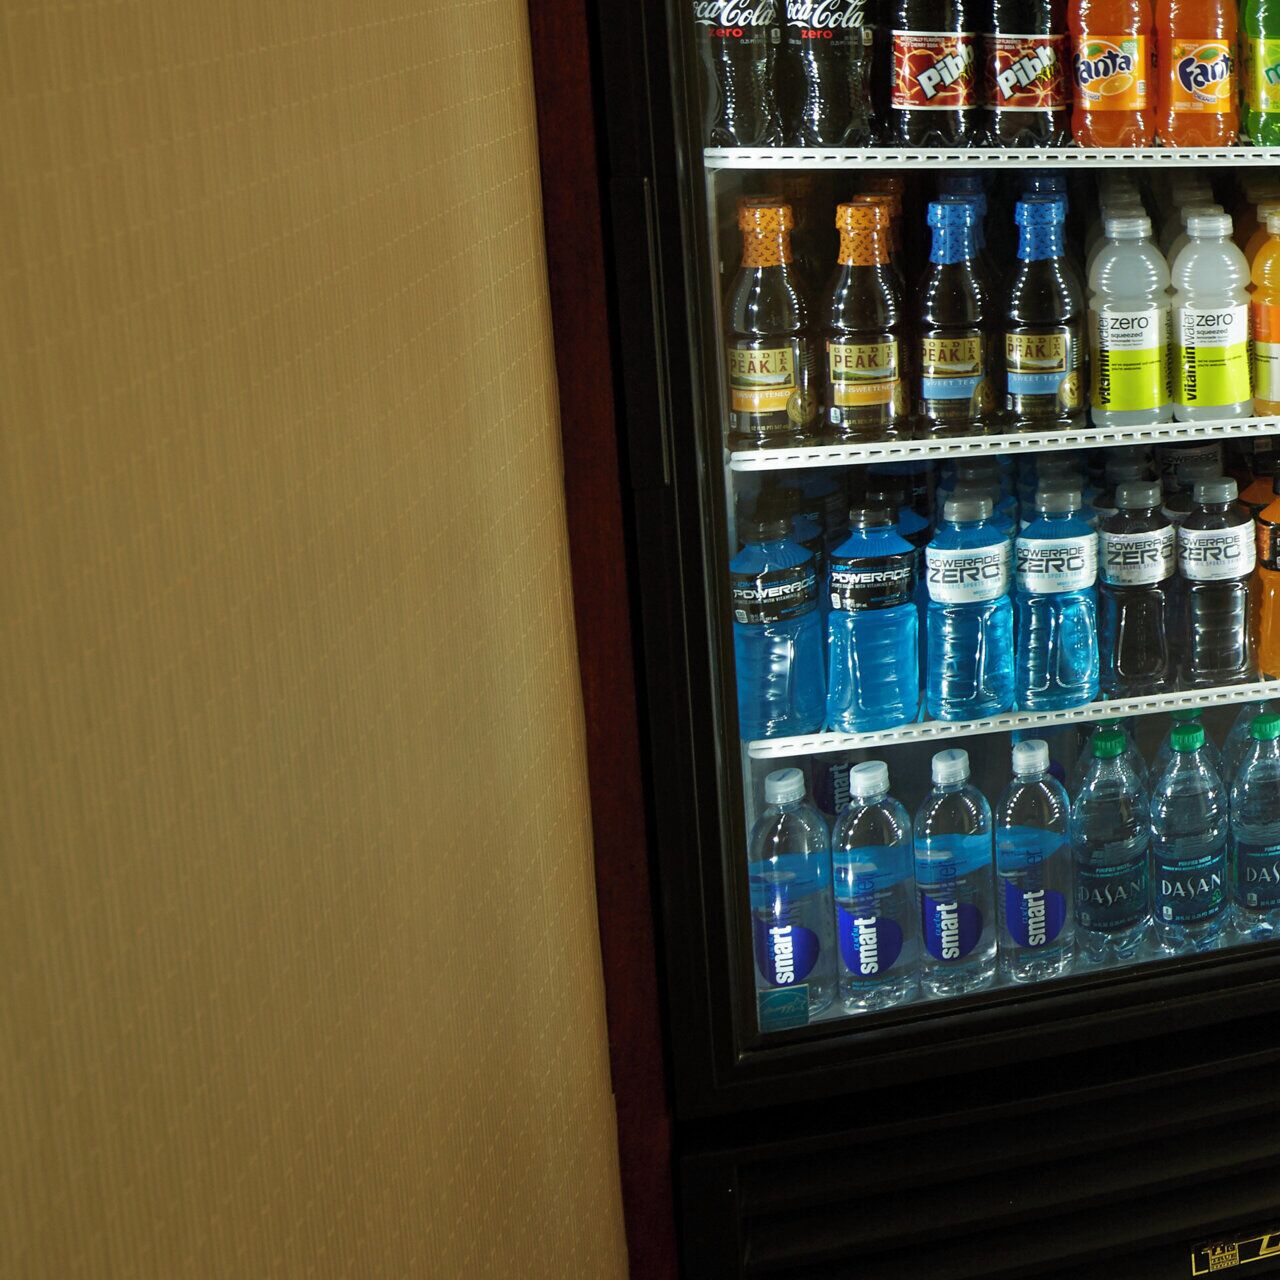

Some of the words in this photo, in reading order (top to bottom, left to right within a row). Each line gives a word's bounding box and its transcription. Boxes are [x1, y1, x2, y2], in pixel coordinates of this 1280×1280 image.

[708, 27, 744, 38] zero
[801, 28, 833, 39] zero
[917, 43, 975, 101] Pibb
[998, 45, 1057, 101] Pibb
[1110, 316, 1149, 330] zero
[1196, 313, 1233, 327] zero
[1111, 332, 1143, 340] squeezed
[1196, 328, 1228, 336] squeezed
[1007, 336, 1046, 344] GOLD
[834, 346, 880, 354] GOLD
[1007, 343, 1047, 358] PEAK
[1183, 312, 1197, 402] vitaminwater
[834, 354, 879, 368] PEAK
[1098, 311, 1111, 405] vitaminwater
[730, 360, 770, 374] PEAK
[1107, 534, 1174, 551] POWERADE
[1179, 535, 1241, 546] POWERADE
[1016, 546, 1085, 558] POWERADE
[1107, 543, 1174, 566] ZERO
[1178, 544, 1241, 562] ZERO
[929, 553, 1000, 568] POWERADE
[1016, 556, 1085, 574] ZERO
[832, 567, 911, 584] POWERADE
[929, 563, 1000, 584] ZERO
[733, 574, 816, 599] POWERADE
